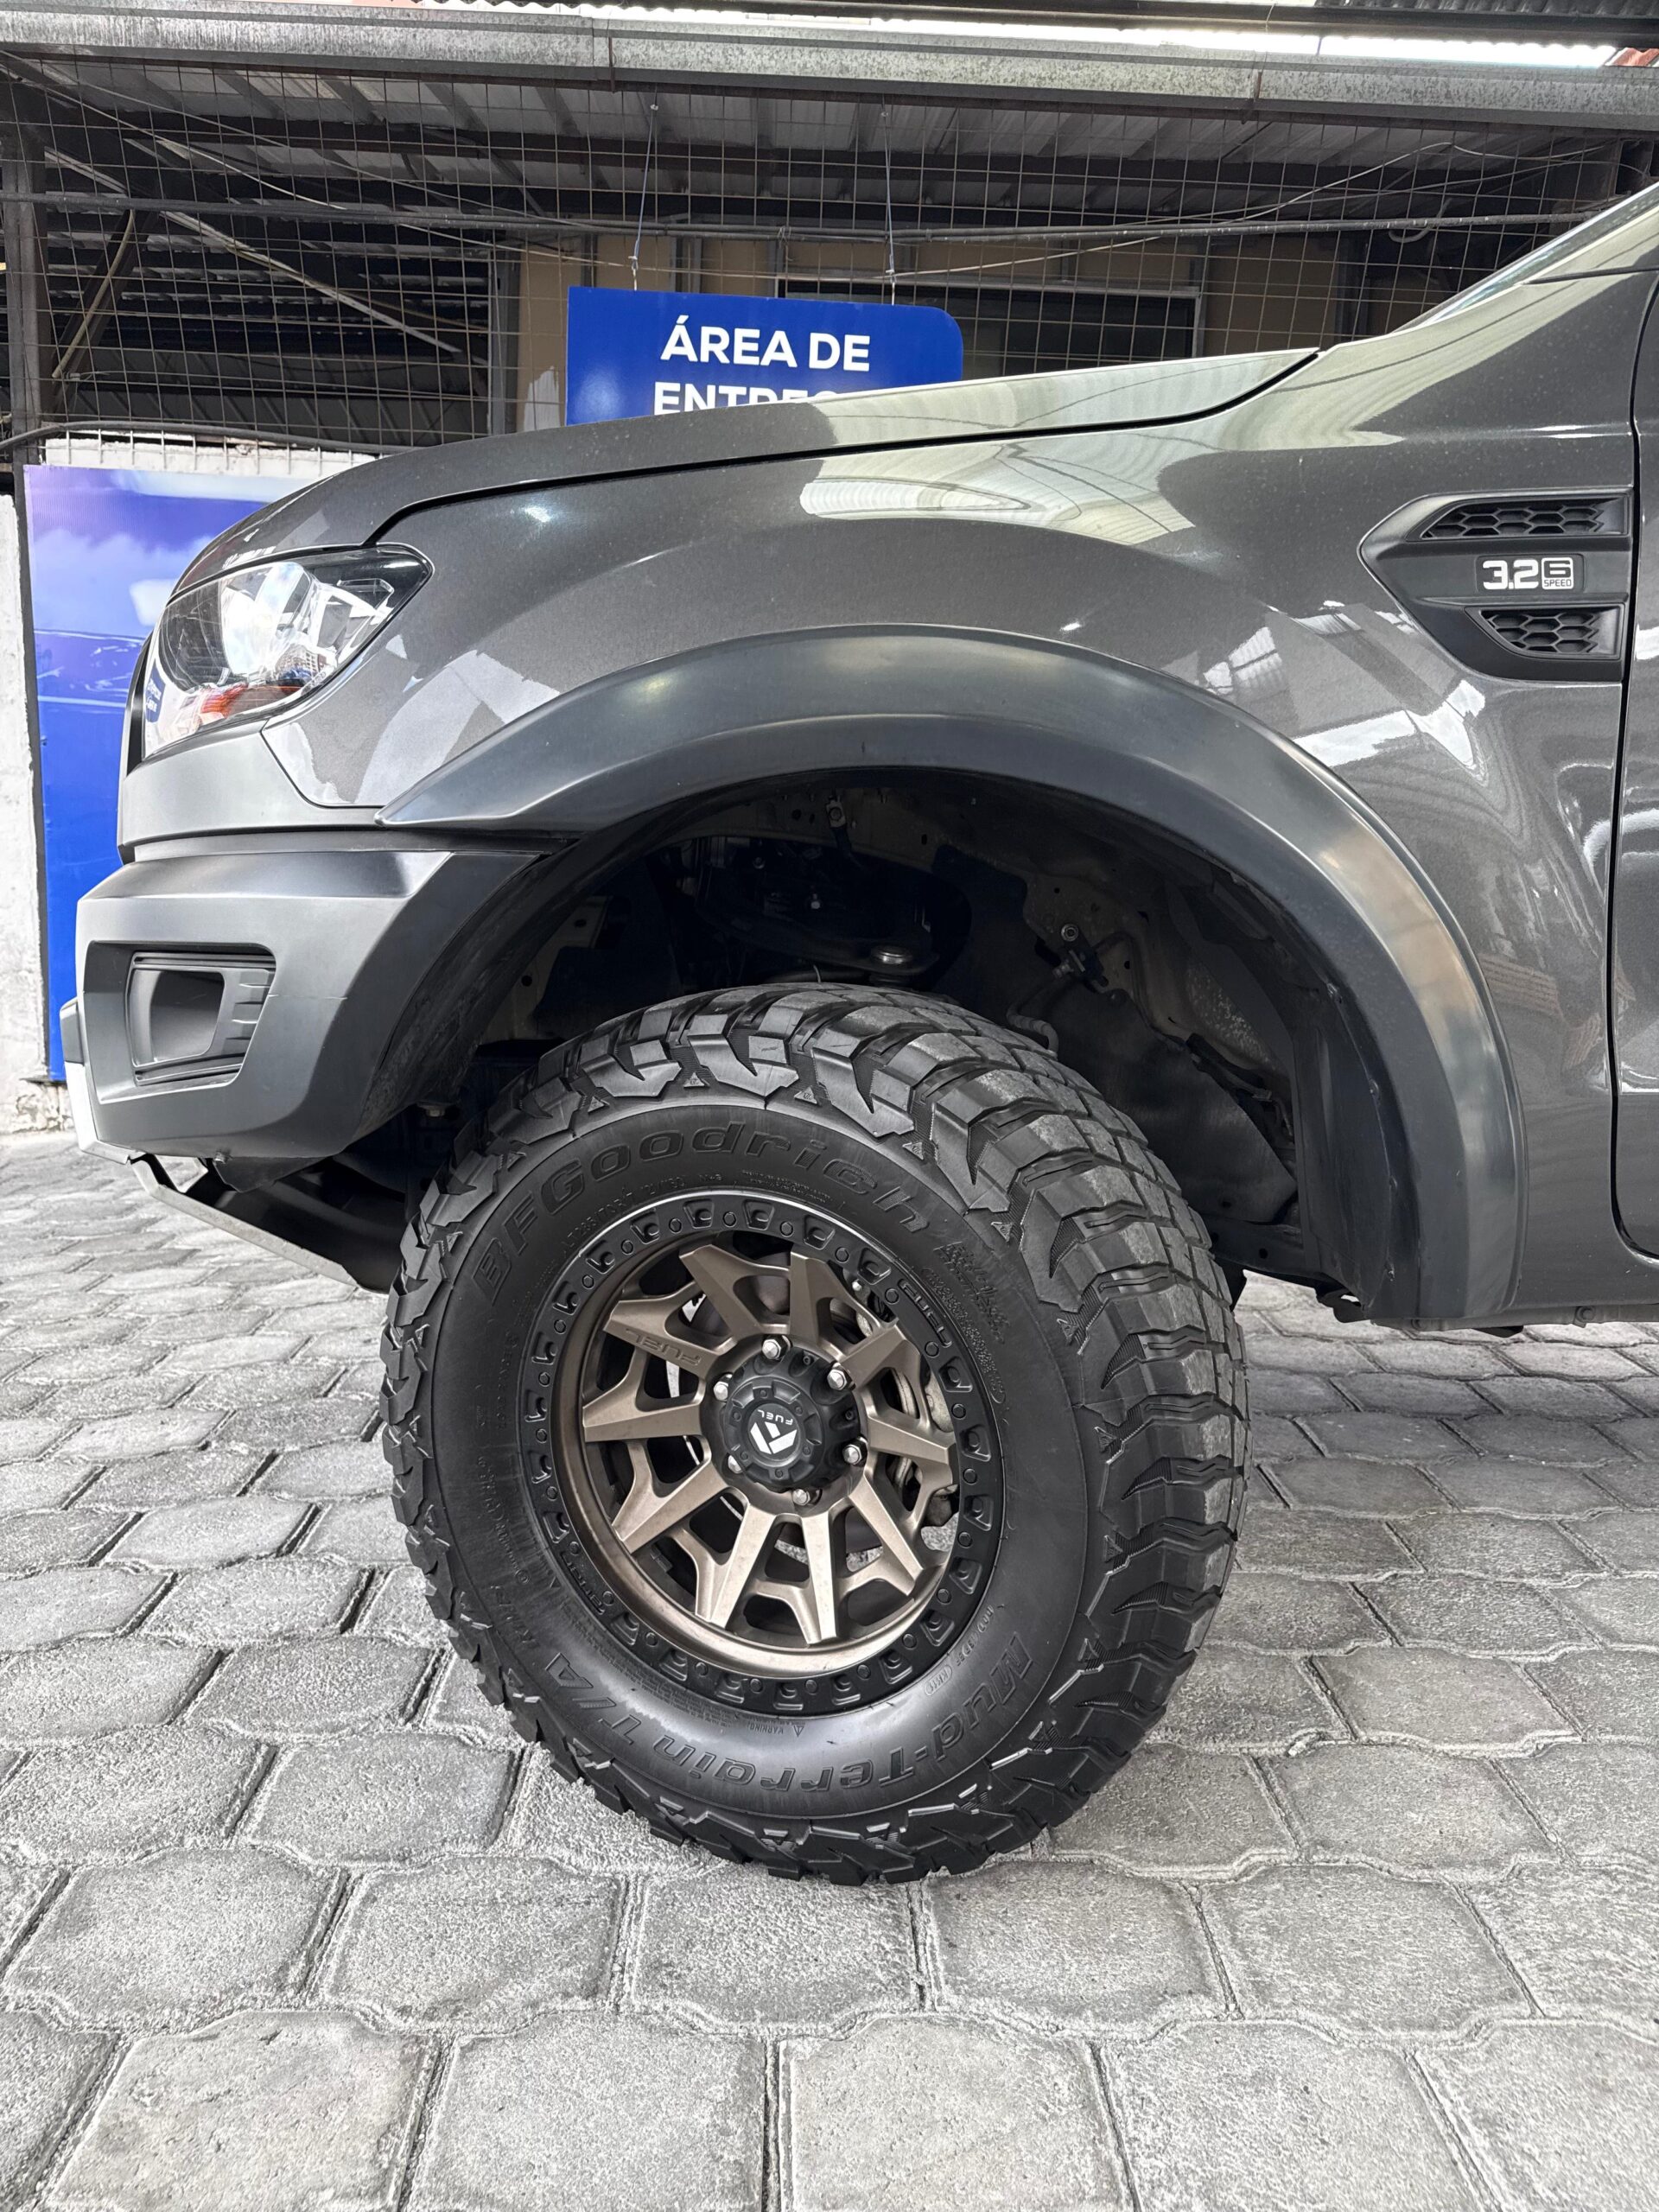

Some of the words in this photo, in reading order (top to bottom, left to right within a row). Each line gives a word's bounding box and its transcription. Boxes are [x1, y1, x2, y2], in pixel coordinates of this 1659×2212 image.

[660, 315, 798, 367] ÁREA
[809, 333, 870, 372] DE
[654, 381, 837, 416] ENT
[1482, 559, 1539, 590] 3.2
[473, 1120, 930, 1307] BFGoodrich
[901, 1281, 951, 1346] FUEL
[626, 1328, 702, 1366] FUEL
[757, 1409, 793, 1426] FUEL
[545, 1652, 642, 1745] T/A
[652, 1631, 1033, 1793] Mud-Terrain
